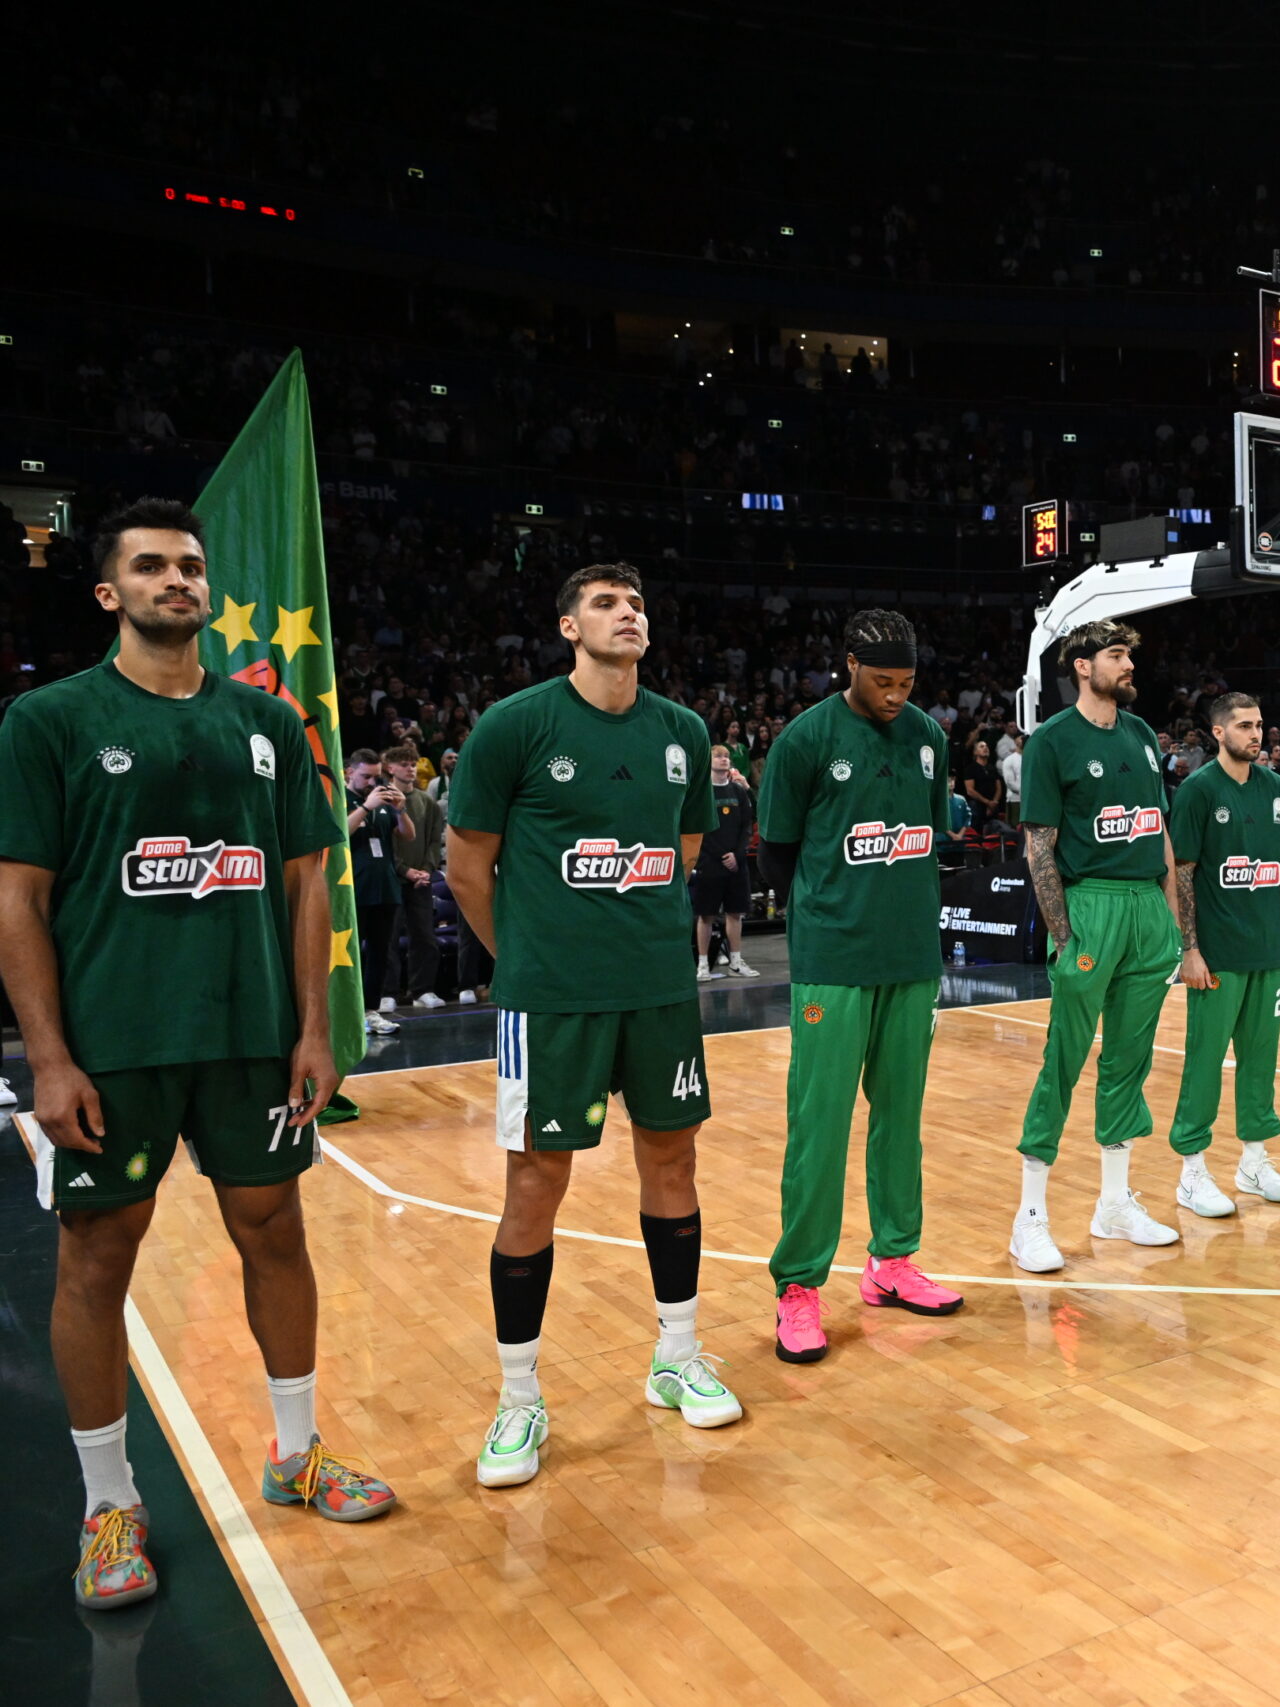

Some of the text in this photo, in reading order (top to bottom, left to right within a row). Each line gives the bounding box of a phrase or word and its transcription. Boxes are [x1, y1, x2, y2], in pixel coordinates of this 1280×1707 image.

[1036, 532, 1054, 556] 24
[144, 842, 183, 856] pame
[582, 843, 613, 854] pame
[953, 907, 972, 920] LIVE
[951, 919, 1018, 937] ENTERTAINMENT
[672, 1057, 702, 1101] 44
